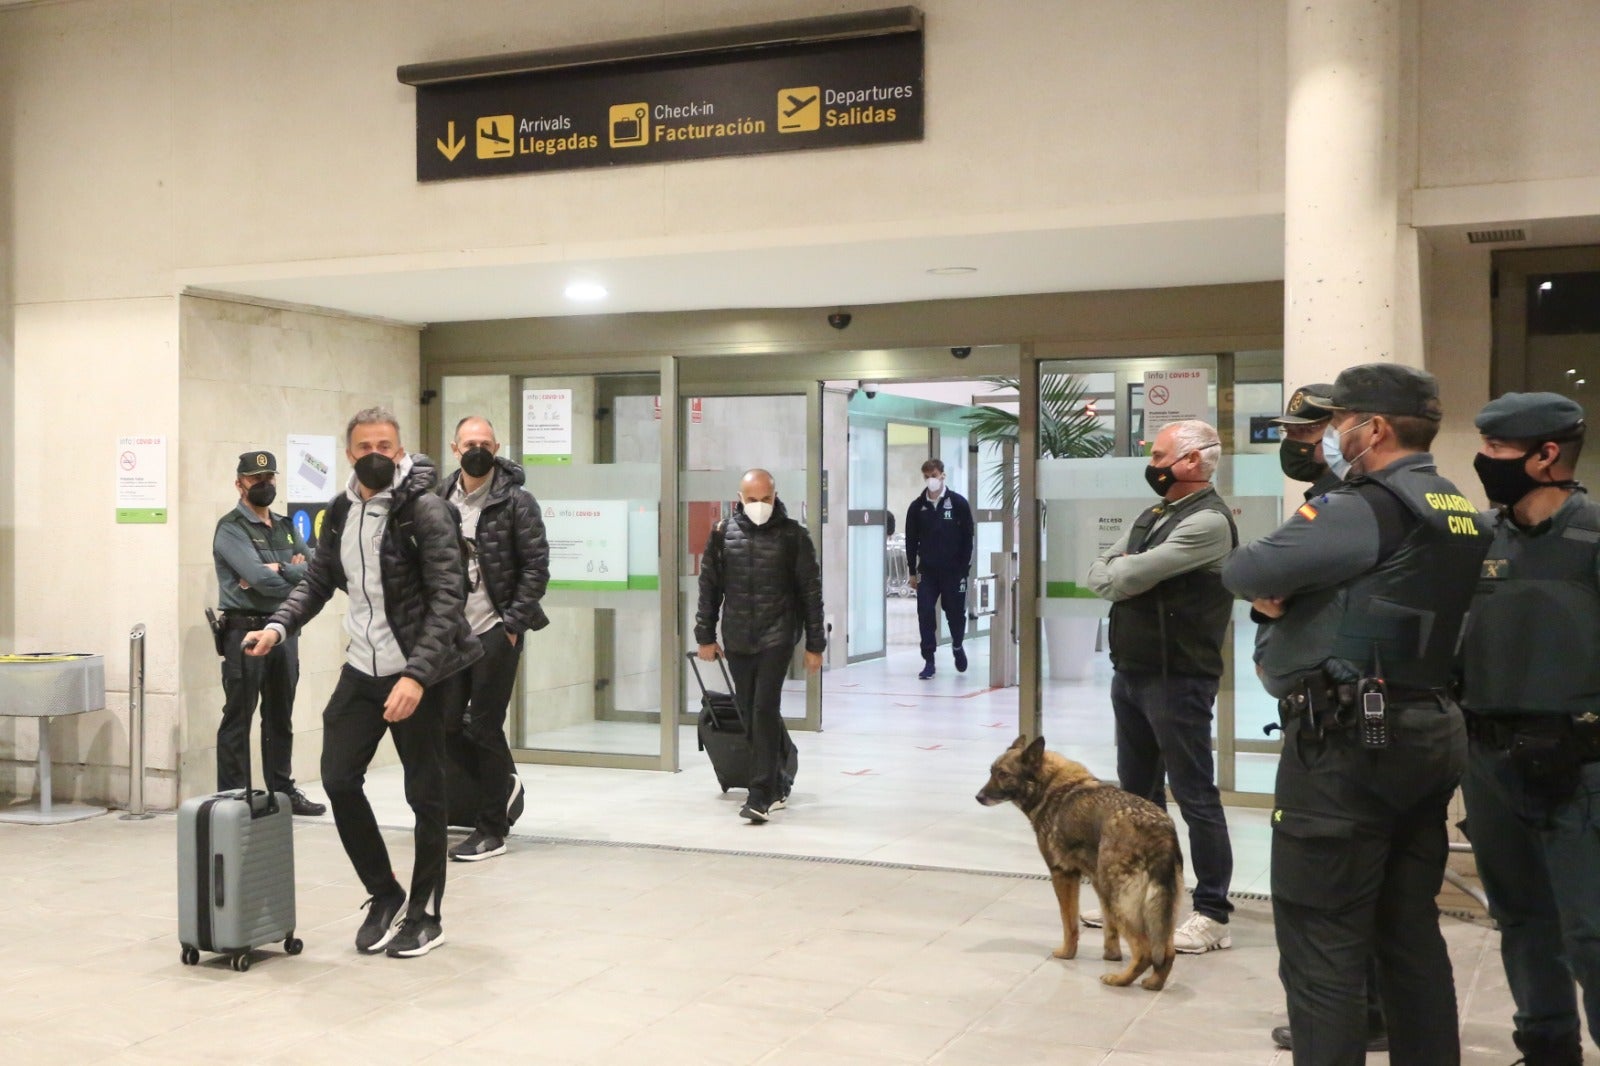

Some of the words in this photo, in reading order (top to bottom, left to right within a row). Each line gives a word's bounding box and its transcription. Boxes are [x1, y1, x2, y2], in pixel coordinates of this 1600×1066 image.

[825, 85, 913, 106] Departures
[654, 100, 714, 120] Check-in
[825, 105, 897, 127] Salidas
[519, 114, 572, 134] Arrivals
[655, 117, 766, 142] Facturación
[520, 133, 598, 155] Llegadas
[1448, 515, 1478, 535] CIVIL
